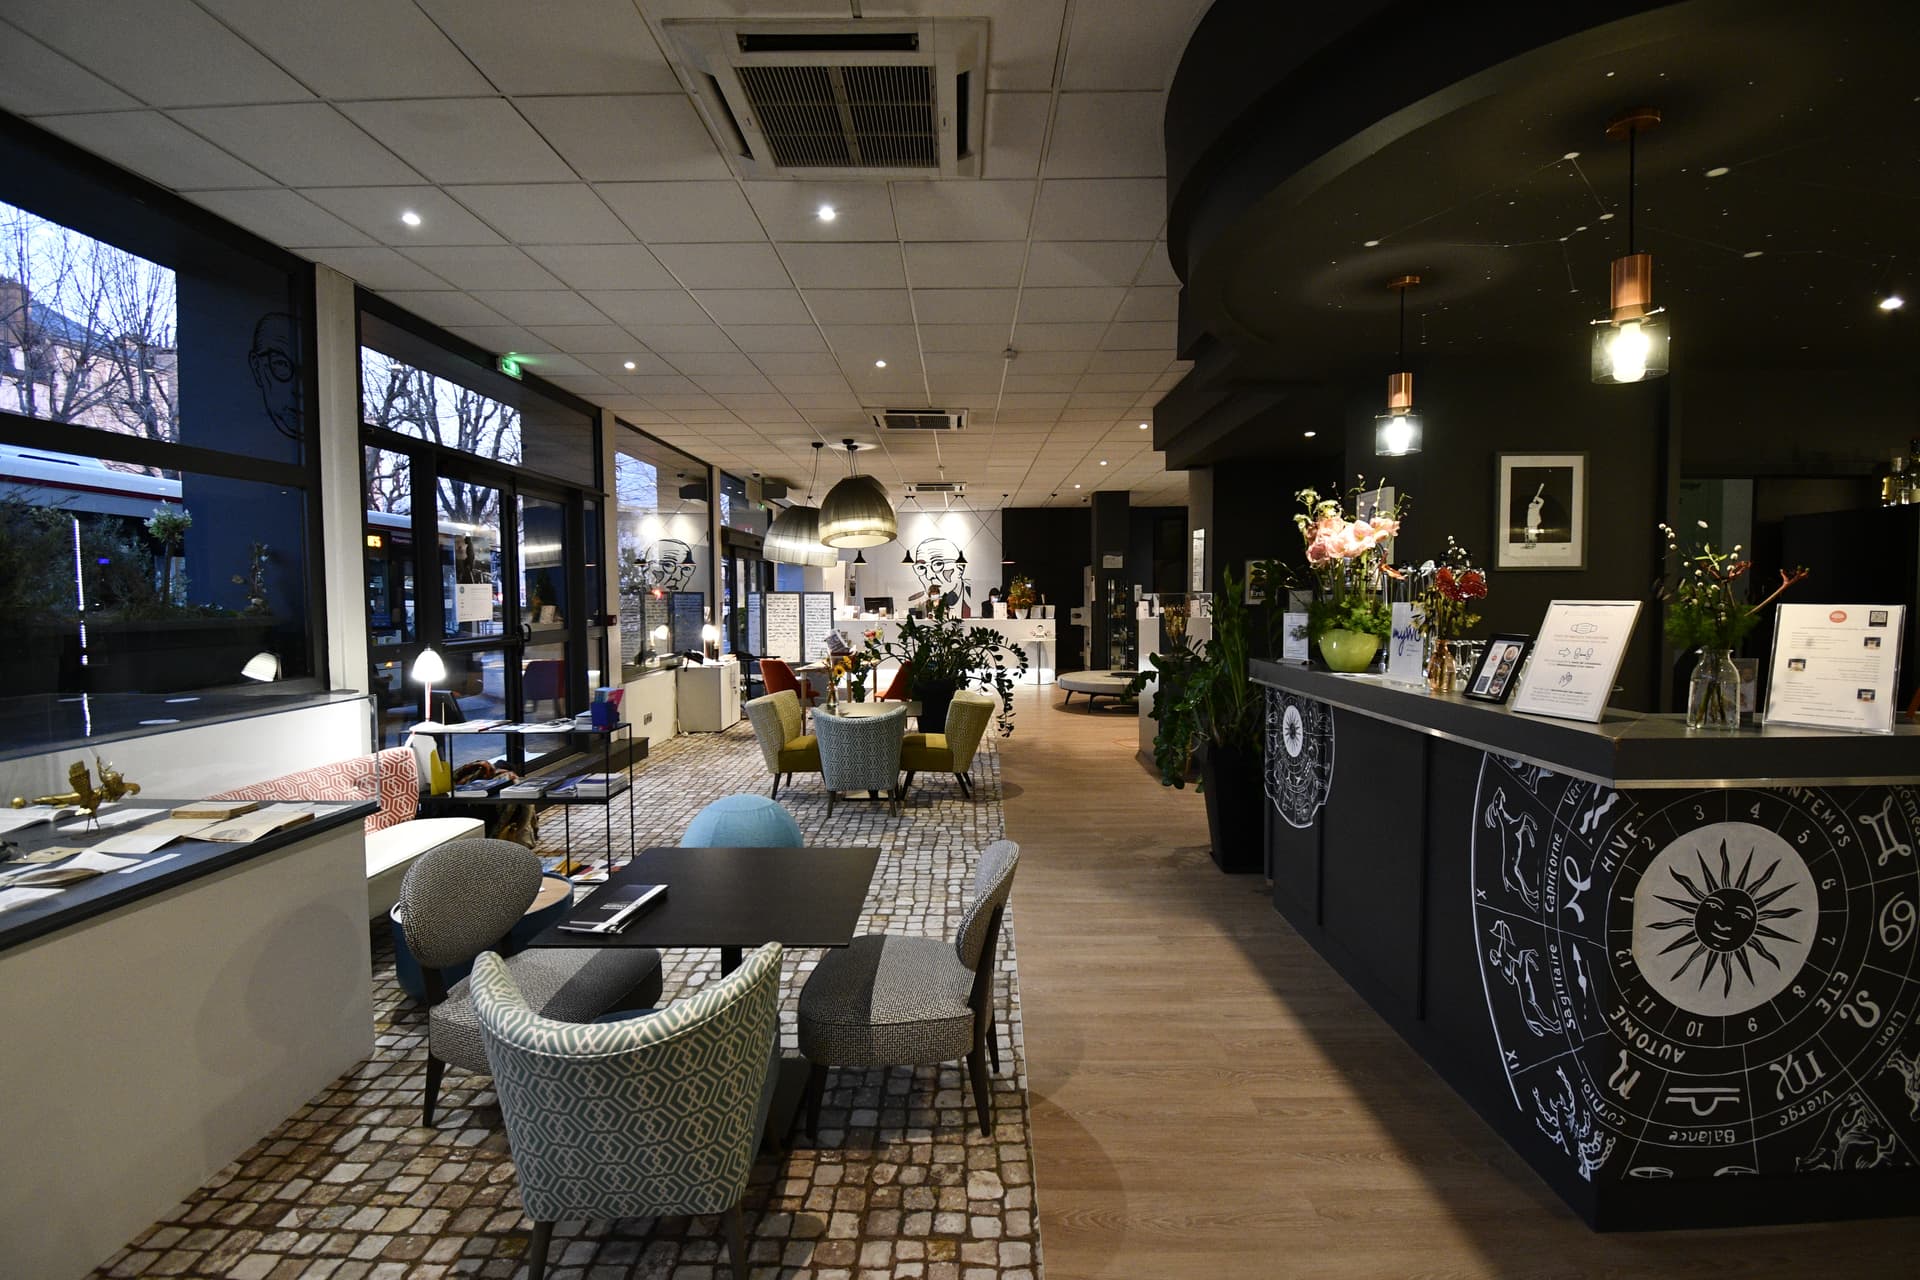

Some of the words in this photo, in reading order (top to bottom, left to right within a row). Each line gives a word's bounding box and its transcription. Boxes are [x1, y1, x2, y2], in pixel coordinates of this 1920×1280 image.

[1693, 804, 1705, 821] 3
[1750, 802, 1761, 819] 4
[1767, 786, 1851, 847] NTEMPS
[1601, 811, 1645, 873] HIVE
[1641, 836, 1656, 851] 2
[1797, 829, 1811, 844] 5
[1544, 833, 1563, 913] Capricorne
[1821, 878, 1837, 890] 6
[1476, 888, 1488, 901] X
[1821, 936, 1837, 946] 7
[1792, 984, 1806, 999] 8
[1636, 995, 1657, 1015] 11
[1686, 1021, 1704, 1038] 10
[1875, 1011, 1907, 1047] Lion
[1779, 1089, 1835, 1127] Vierge
[1668, 1129, 1736, 1146] Balance
